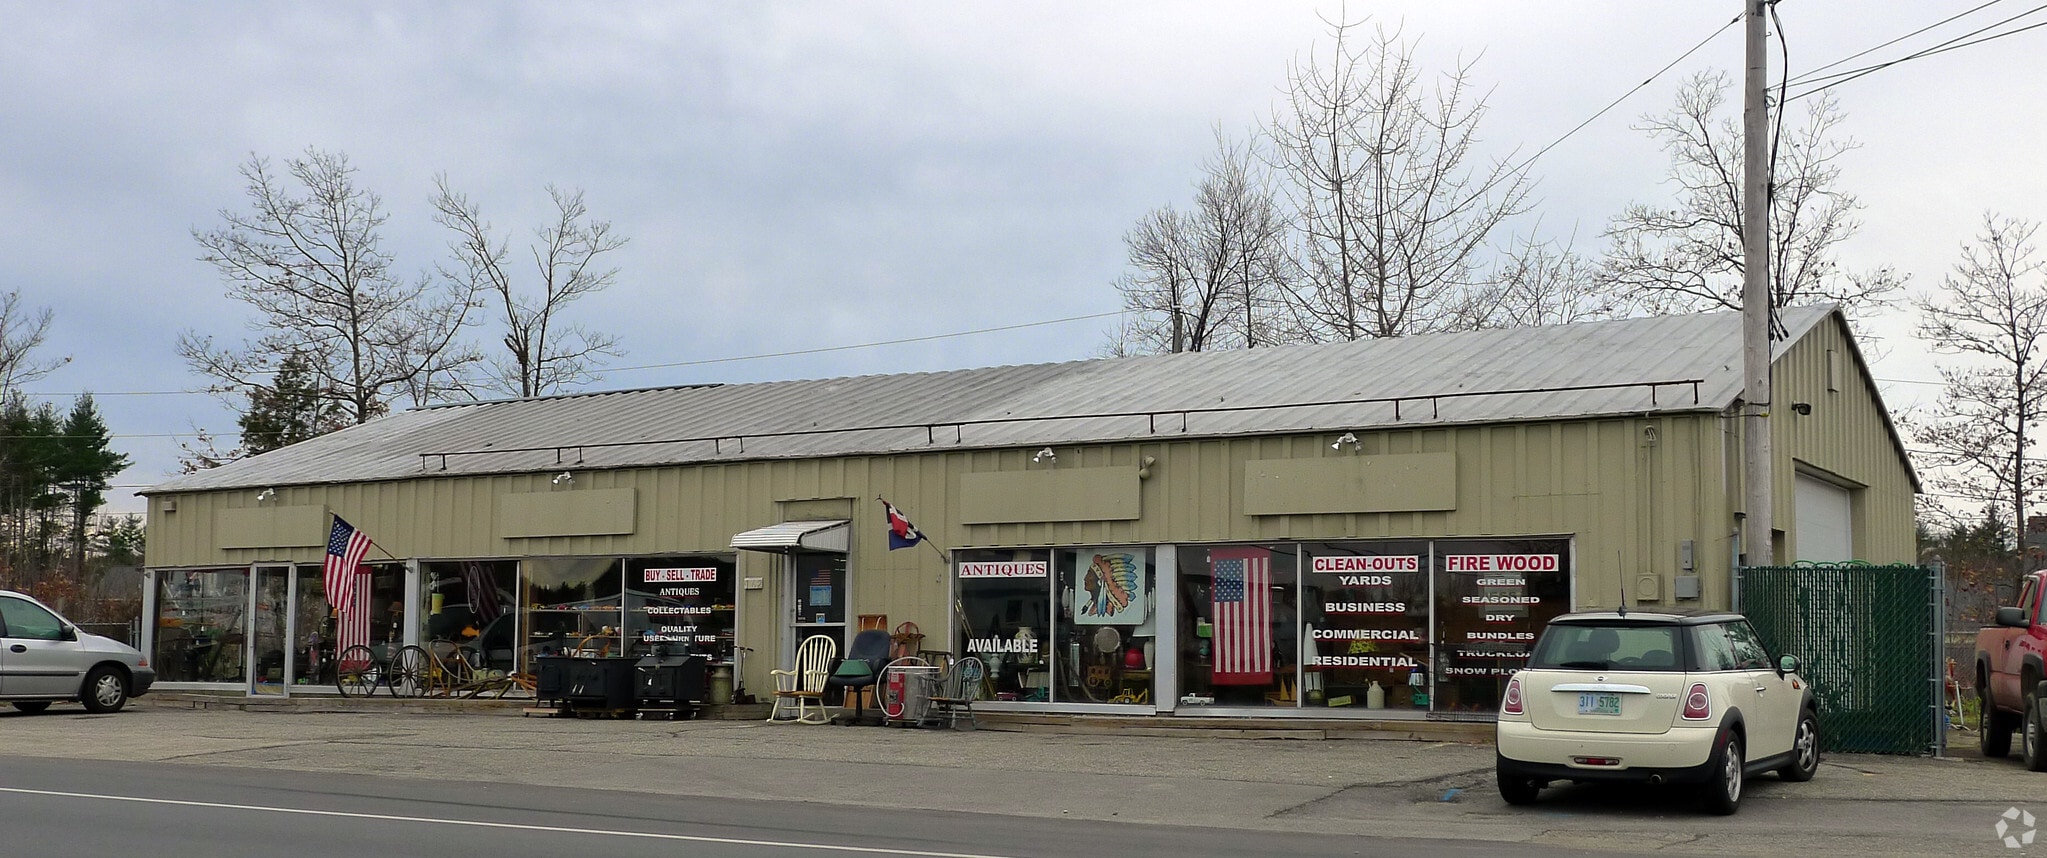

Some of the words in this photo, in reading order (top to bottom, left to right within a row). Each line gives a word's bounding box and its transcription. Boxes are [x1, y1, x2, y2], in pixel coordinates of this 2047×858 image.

[1314, 557, 1417, 571] CLEAN-OUTS
[1448, 556, 1490, 571] FIRE
[1496, 555, 1555, 571] WOOD
[645, 570, 660, 581] BUY
[666, 569, 684, 580] SELL
[690, 569, 715, 580] TRADE
[960, 563, 1046, 576] ANTIQUES
[1339, 575, 1392, 586] YARDS
[1476, 578, 1526, 586] GREEN
[660, 588, 700, 596] ANTIQUES
[1462, 596, 1541, 604] SEASONED
[647, 606, 712, 615] COLLECTABLES
[1325, 602, 1406, 613] BUSINESS
[1485, 614, 1515, 622] DRY
[1312, 629, 1419, 640] COMMERCIAL
[1466, 632, 1535, 640] BUNDLES
[967, 639, 1038, 653] AVAILABLE
[1313, 655, 1418, 667] RESIDENTIAL
[1445, 667, 1487, 675] SNOW
